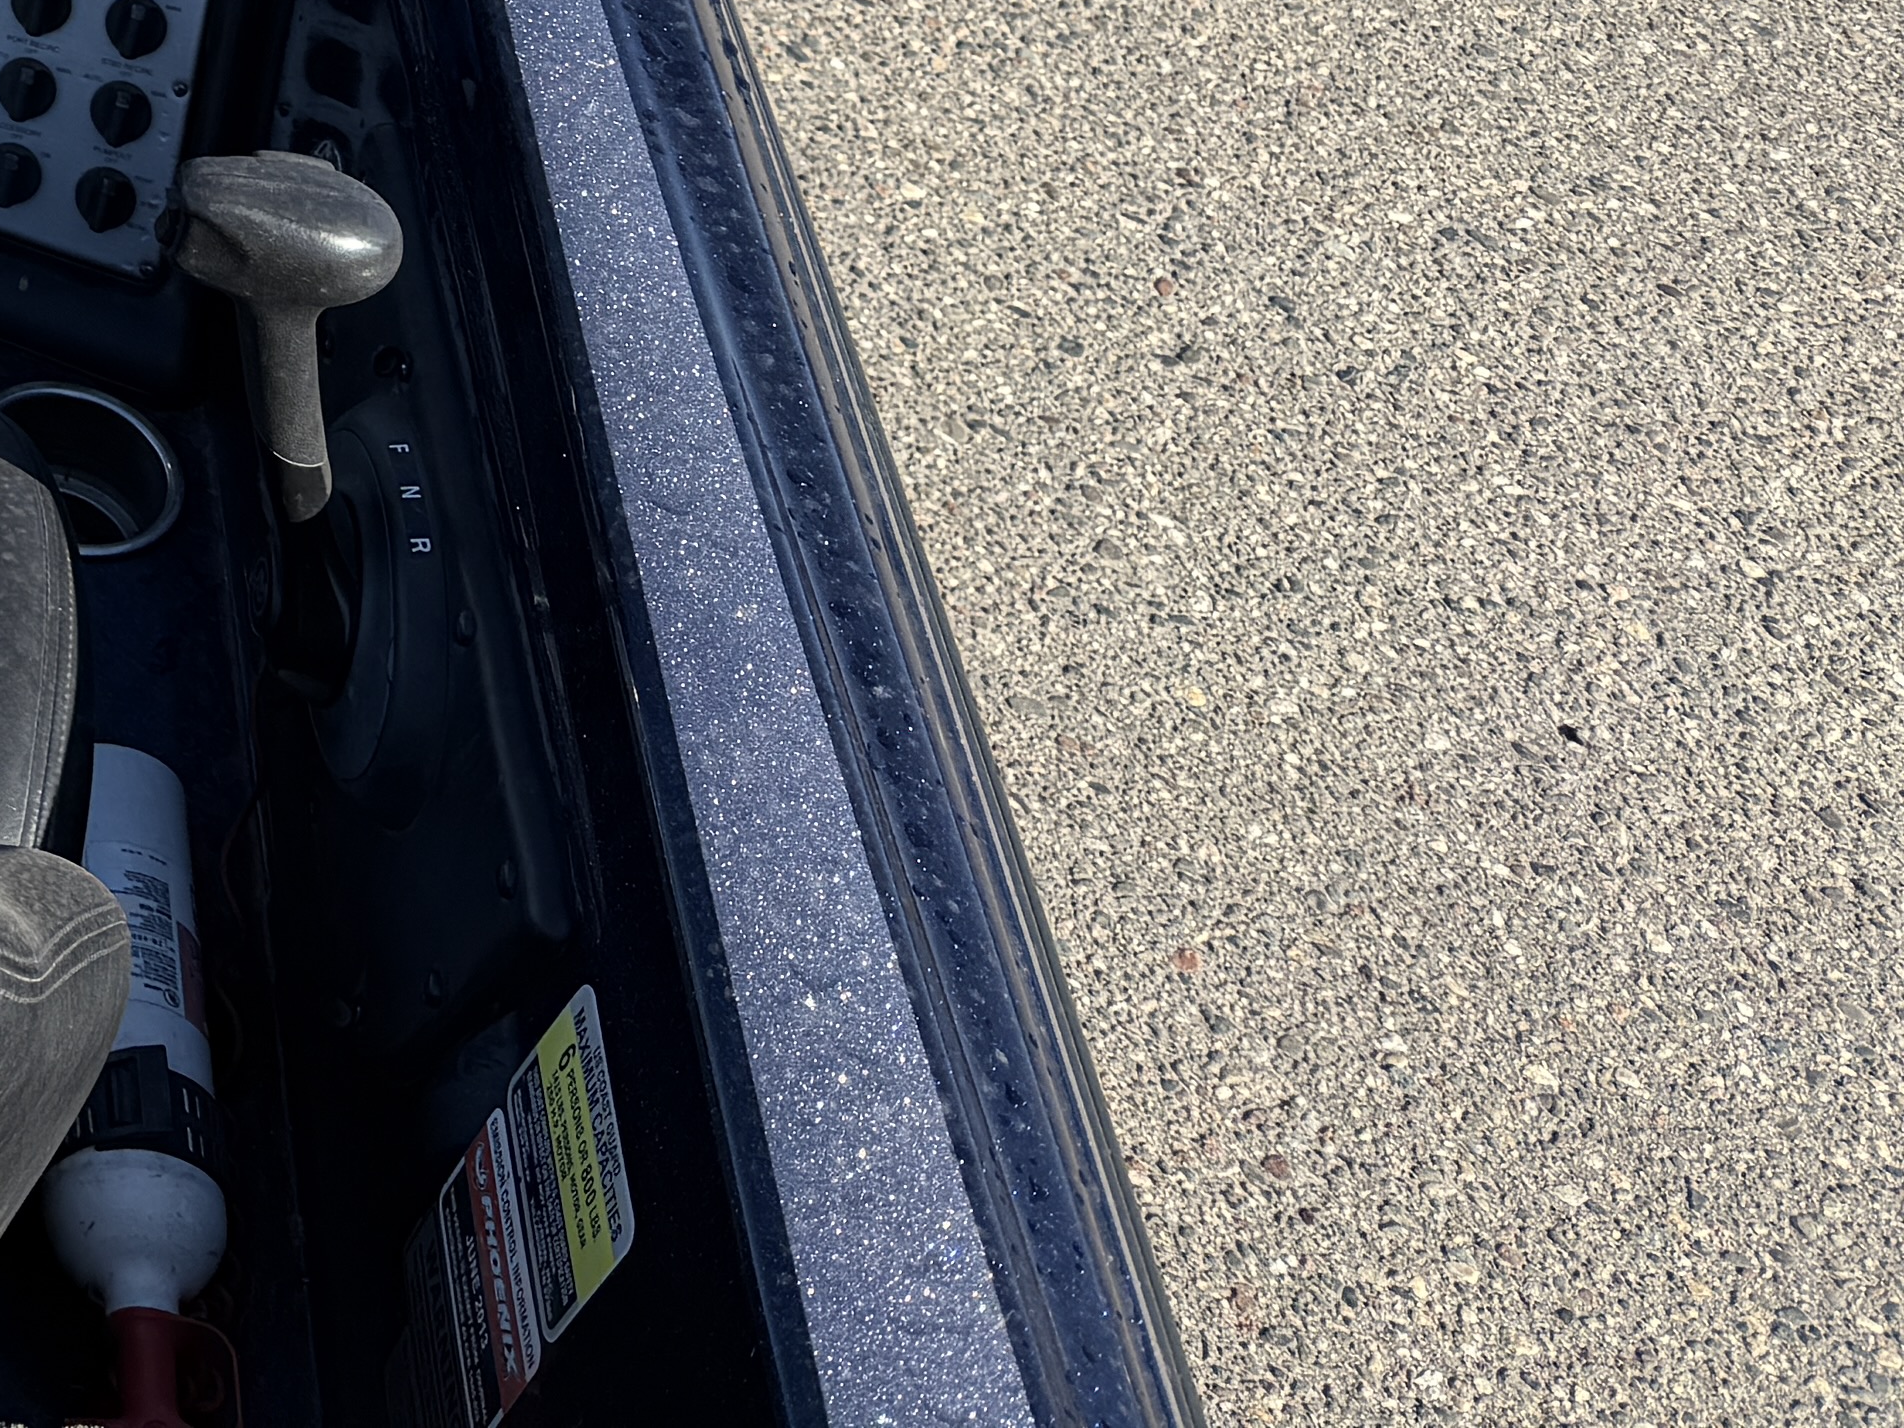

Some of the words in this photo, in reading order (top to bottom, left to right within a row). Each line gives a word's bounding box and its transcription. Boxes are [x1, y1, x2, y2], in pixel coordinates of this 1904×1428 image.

[388, 444, 410, 453] F
[400, 486, 422, 499] N
[410, 538, 432, 552] R
[558, 1039, 576, 1074] 6
[565, 1066, 584, 1142] PERSONS
[596, 1066, 611, 1122] COAST
[573, 1005, 599, 1114] MAXIMUM
[592, 1115, 622, 1244] CAPACITIES
[555, 1132, 567, 1181] MOTOR
[577, 1137, 588, 1166] OR
[580, 1160, 596, 1209] 800
[466, 1235, 481, 1294] JUNE
[474, 1295, 490, 1350] 2013
[480, 1194, 517, 1381] PHOENIX
[499, 1186, 518, 1263] CONTROL
[512, 1260, 535, 1370] INFORMATION
